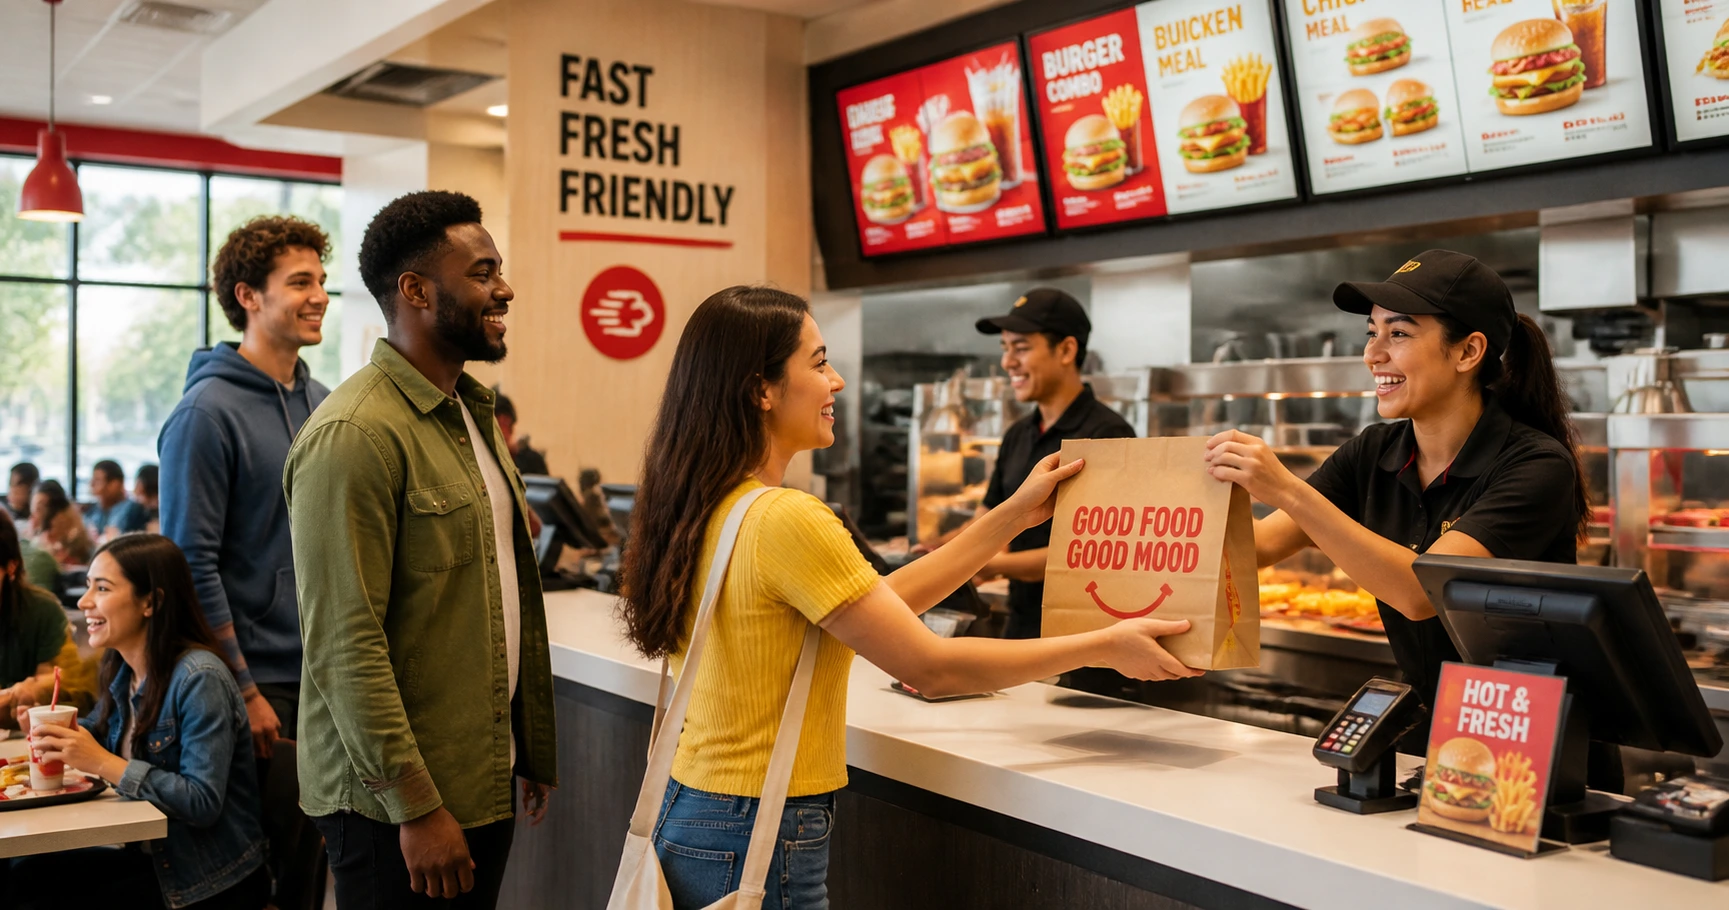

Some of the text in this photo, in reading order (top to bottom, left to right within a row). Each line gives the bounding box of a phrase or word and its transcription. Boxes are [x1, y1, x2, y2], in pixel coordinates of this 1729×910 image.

[1154, 4, 1243, 50] BUICKEN
[1306, 14, 1351, 42] MEAL
[1042, 33, 1125, 79] BURGER
[1157, 48, 1207, 77] MEAL
[560, 53, 654, 108] FAST
[1046, 70, 1103, 103] COMBO
[559, 111, 681, 166] FRESH
[559, 169, 735, 225] FRIENDLY
[1072, 505, 1204, 538] GOOD FOOD
[1066, 539, 1200, 573] GOOD MOOD
[1462, 678, 1530, 713] HOT &
[1457, 705, 1531, 744] FRESH
